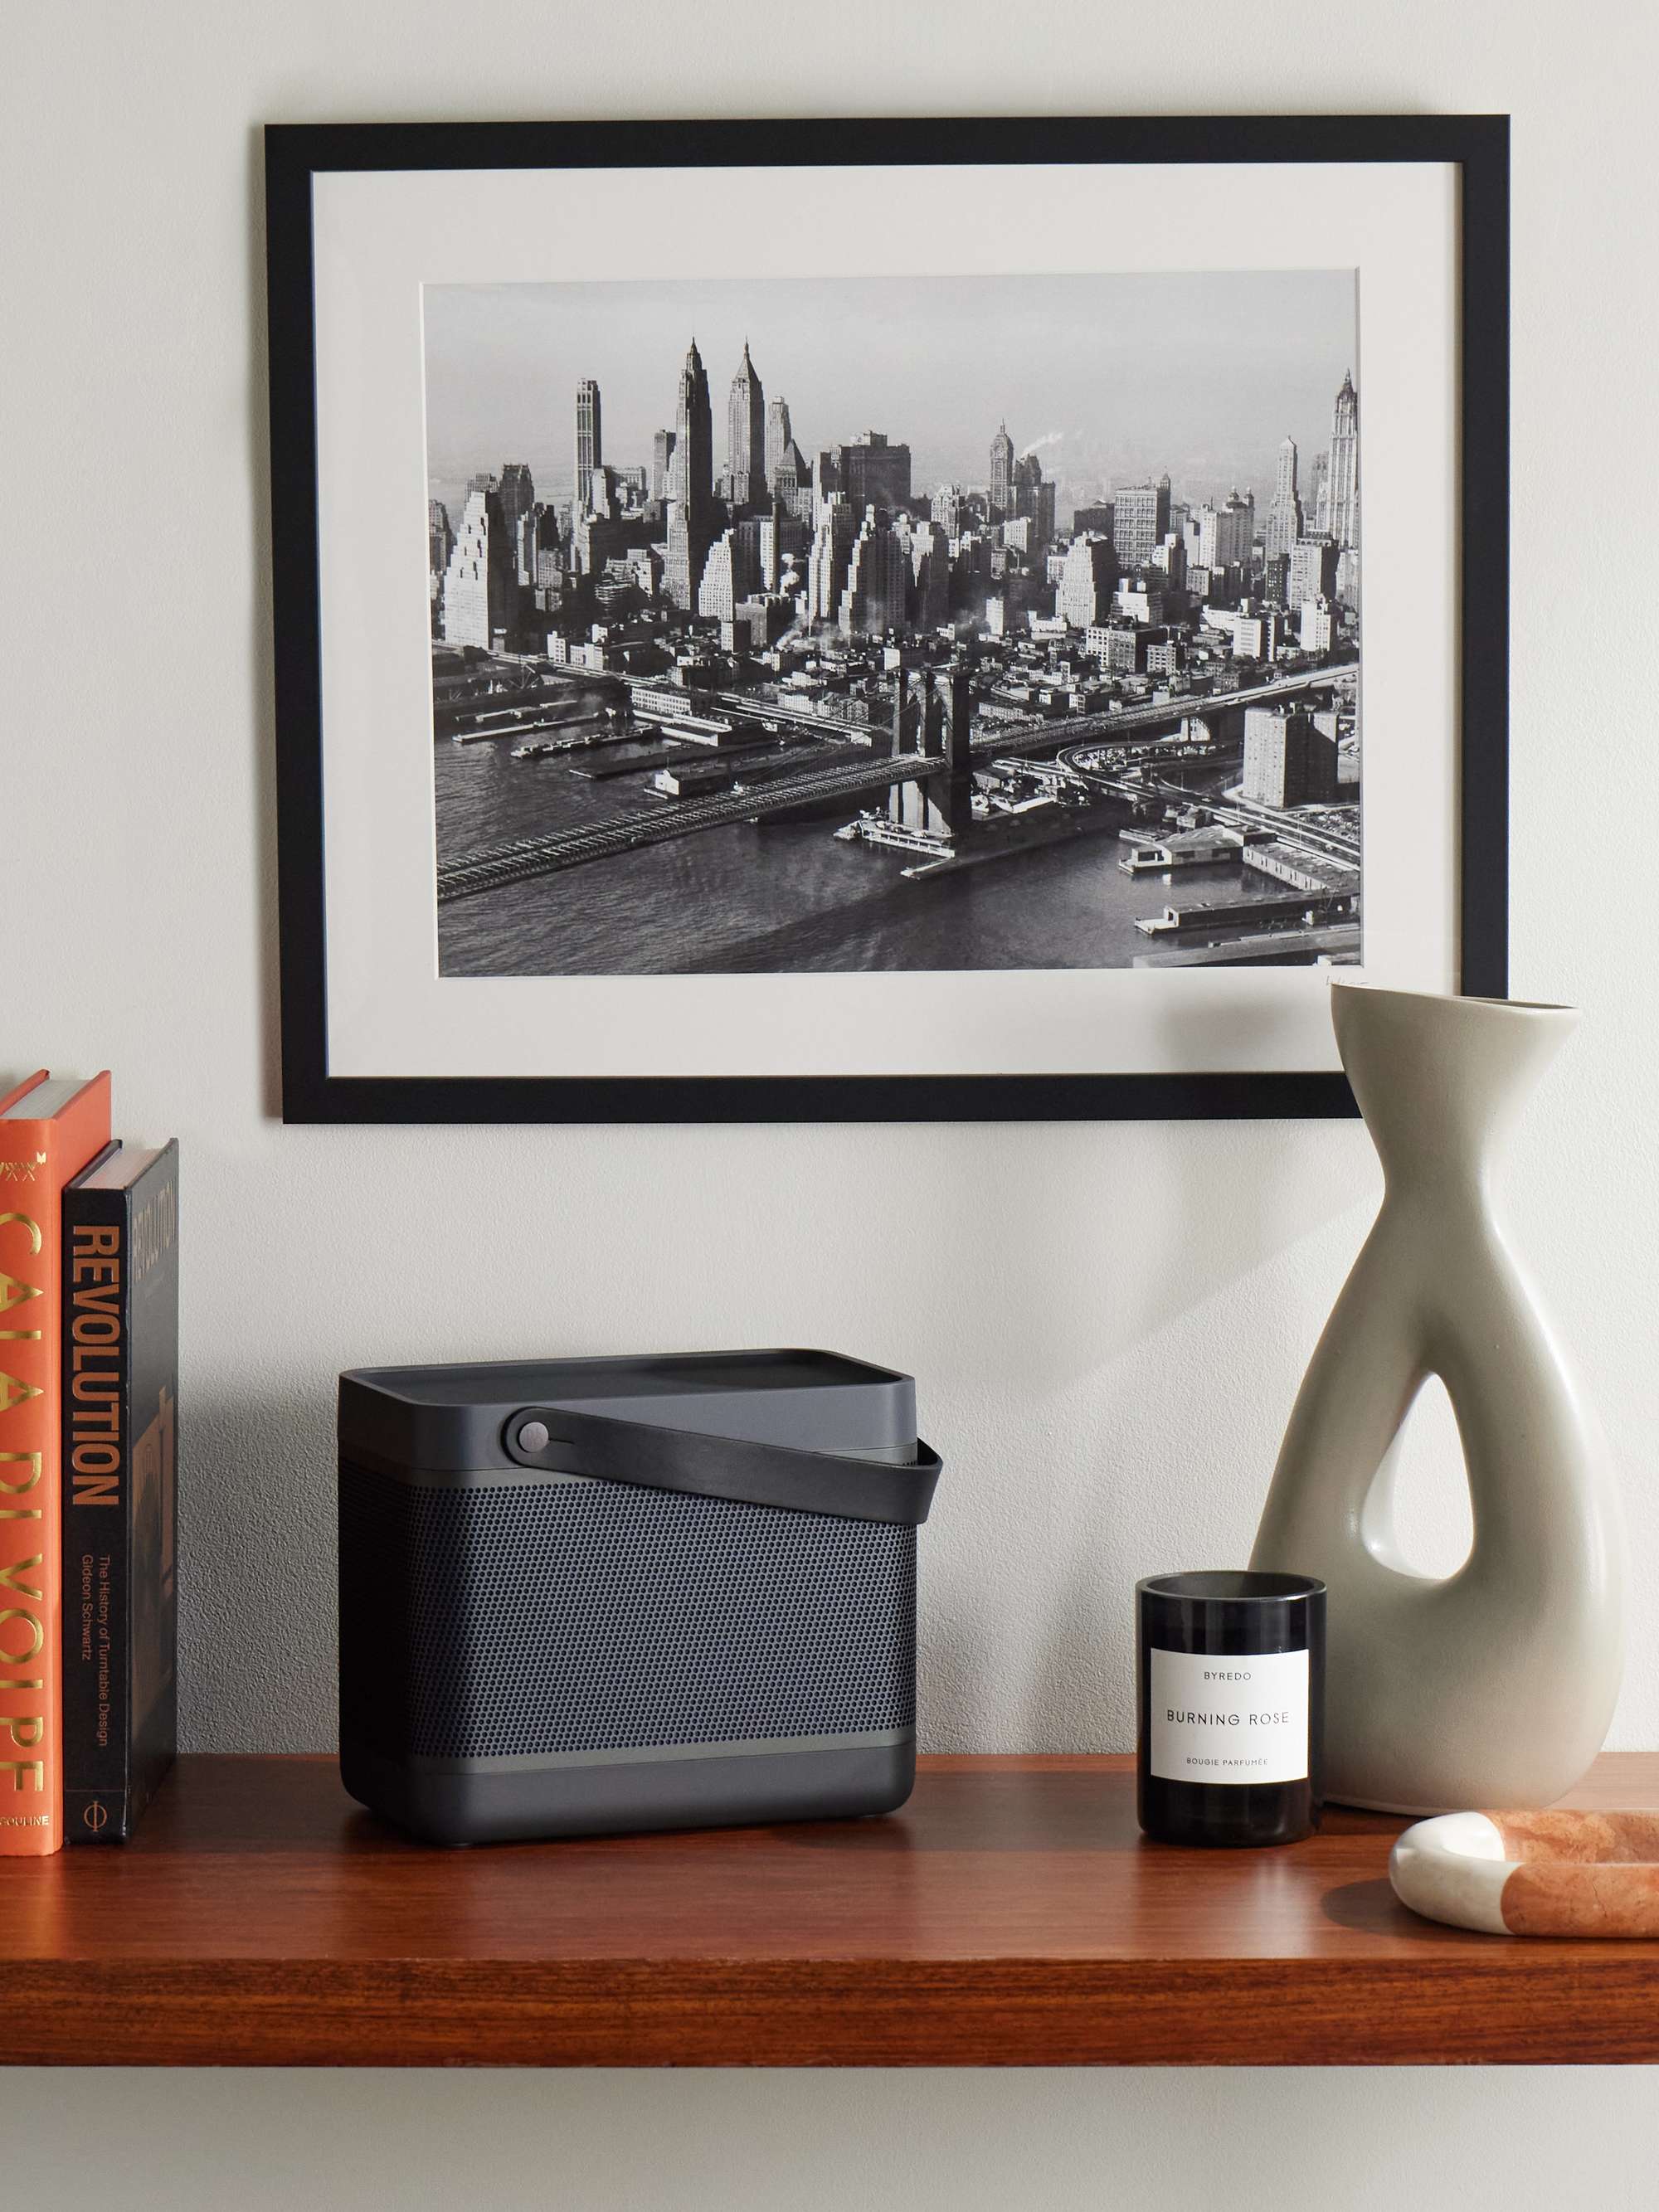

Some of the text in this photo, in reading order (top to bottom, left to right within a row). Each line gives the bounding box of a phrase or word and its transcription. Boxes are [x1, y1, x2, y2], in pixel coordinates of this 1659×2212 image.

[71, 1225, 121, 1506] REVOLUTION
[81, 1553, 95, 1661] Gideon Schwartz
[96, 1555, 111, 1747] The History of Turntable Design
[1204, 1671, 1252, 1680] BYREDO
[1167, 1709, 1289, 1726] BURNING ROSE
[1186, 1757, 1219, 1766] BOUGIE
